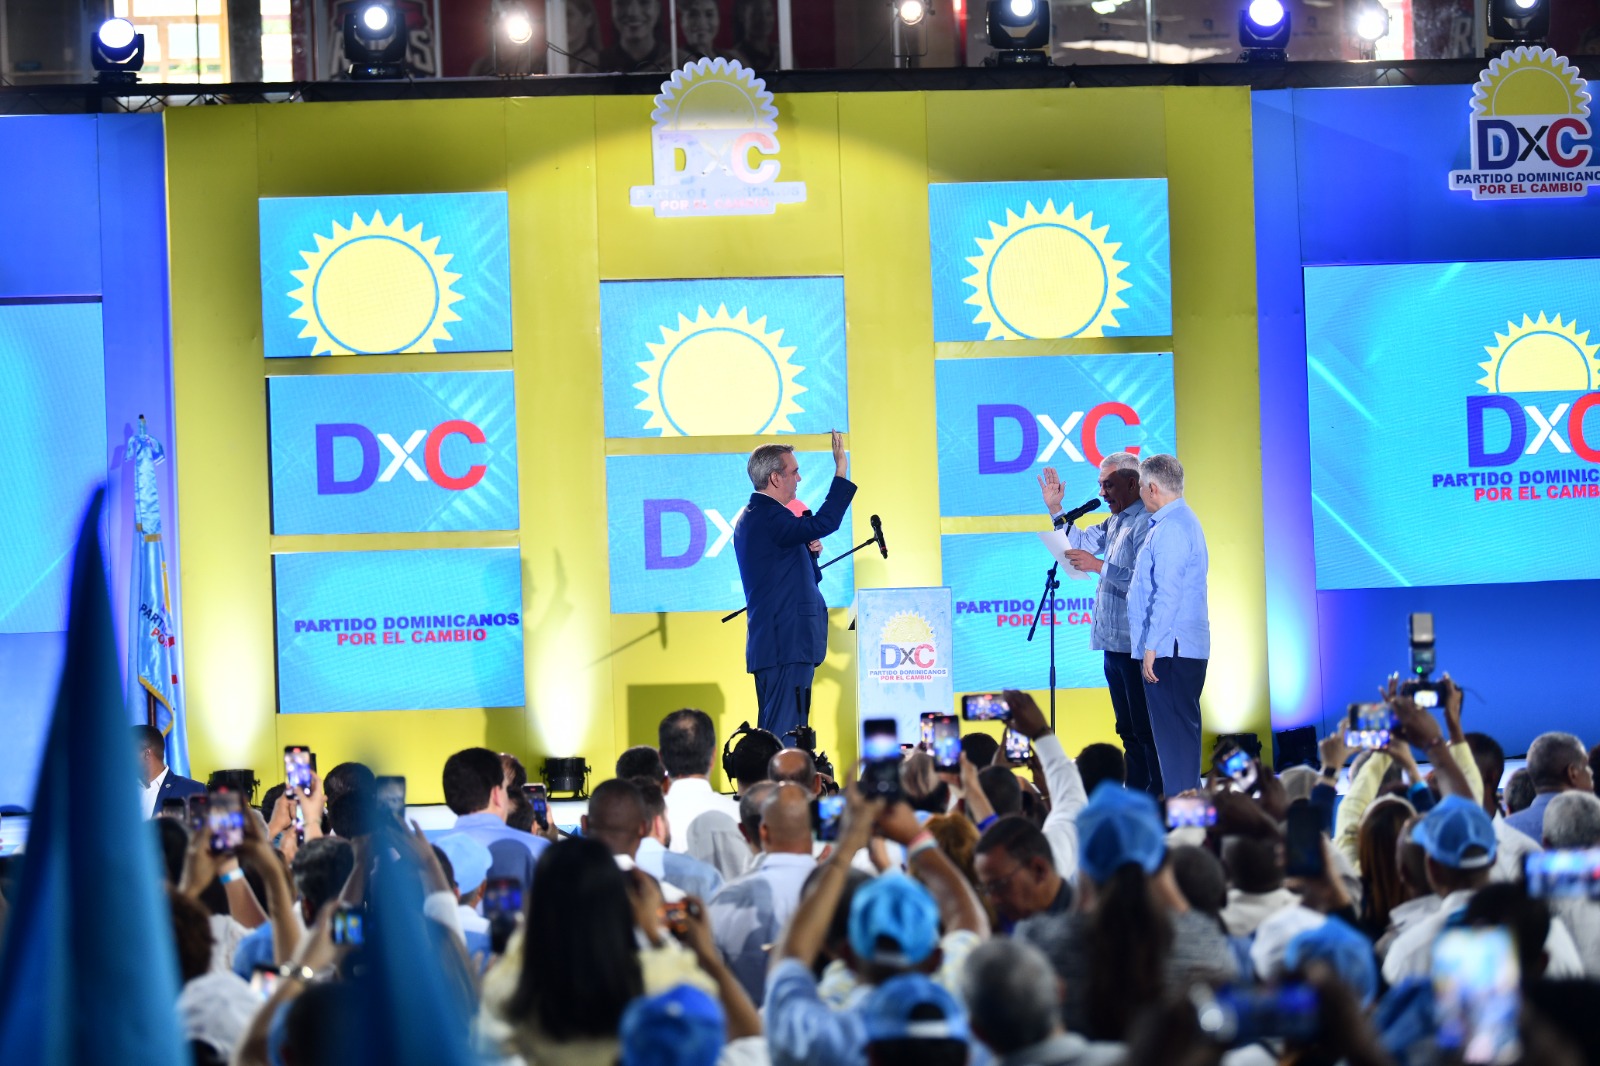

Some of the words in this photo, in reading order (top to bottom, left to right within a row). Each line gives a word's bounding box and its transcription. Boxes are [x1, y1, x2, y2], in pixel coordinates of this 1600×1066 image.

[1456, 173, 1513, 184] PARTIDO
[1479, 184, 1506, 194] POR
[1510, 184, 1526, 193] EL
[1530, 182, 1583, 193] CAMBIO
[660, 200, 688, 211] POR
[1432, 471, 1513, 488] PARTIDO
[1474, 487, 1513, 502] POR
[1518, 486, 1541, 500] EL
[955, 599, 1035, 614] PARTIDO
[294, 617, 377, 633] PARTIDO
[383, 613, 520, 630] DOMINICANOS
[996, 613, 1034, 627] POR
[1041, 613, 1062, 626] EL
[337, 632, 377, 646] POR
[383, 630, 405, 644] EL
[411, 628, 487, 643] CAMBIO
